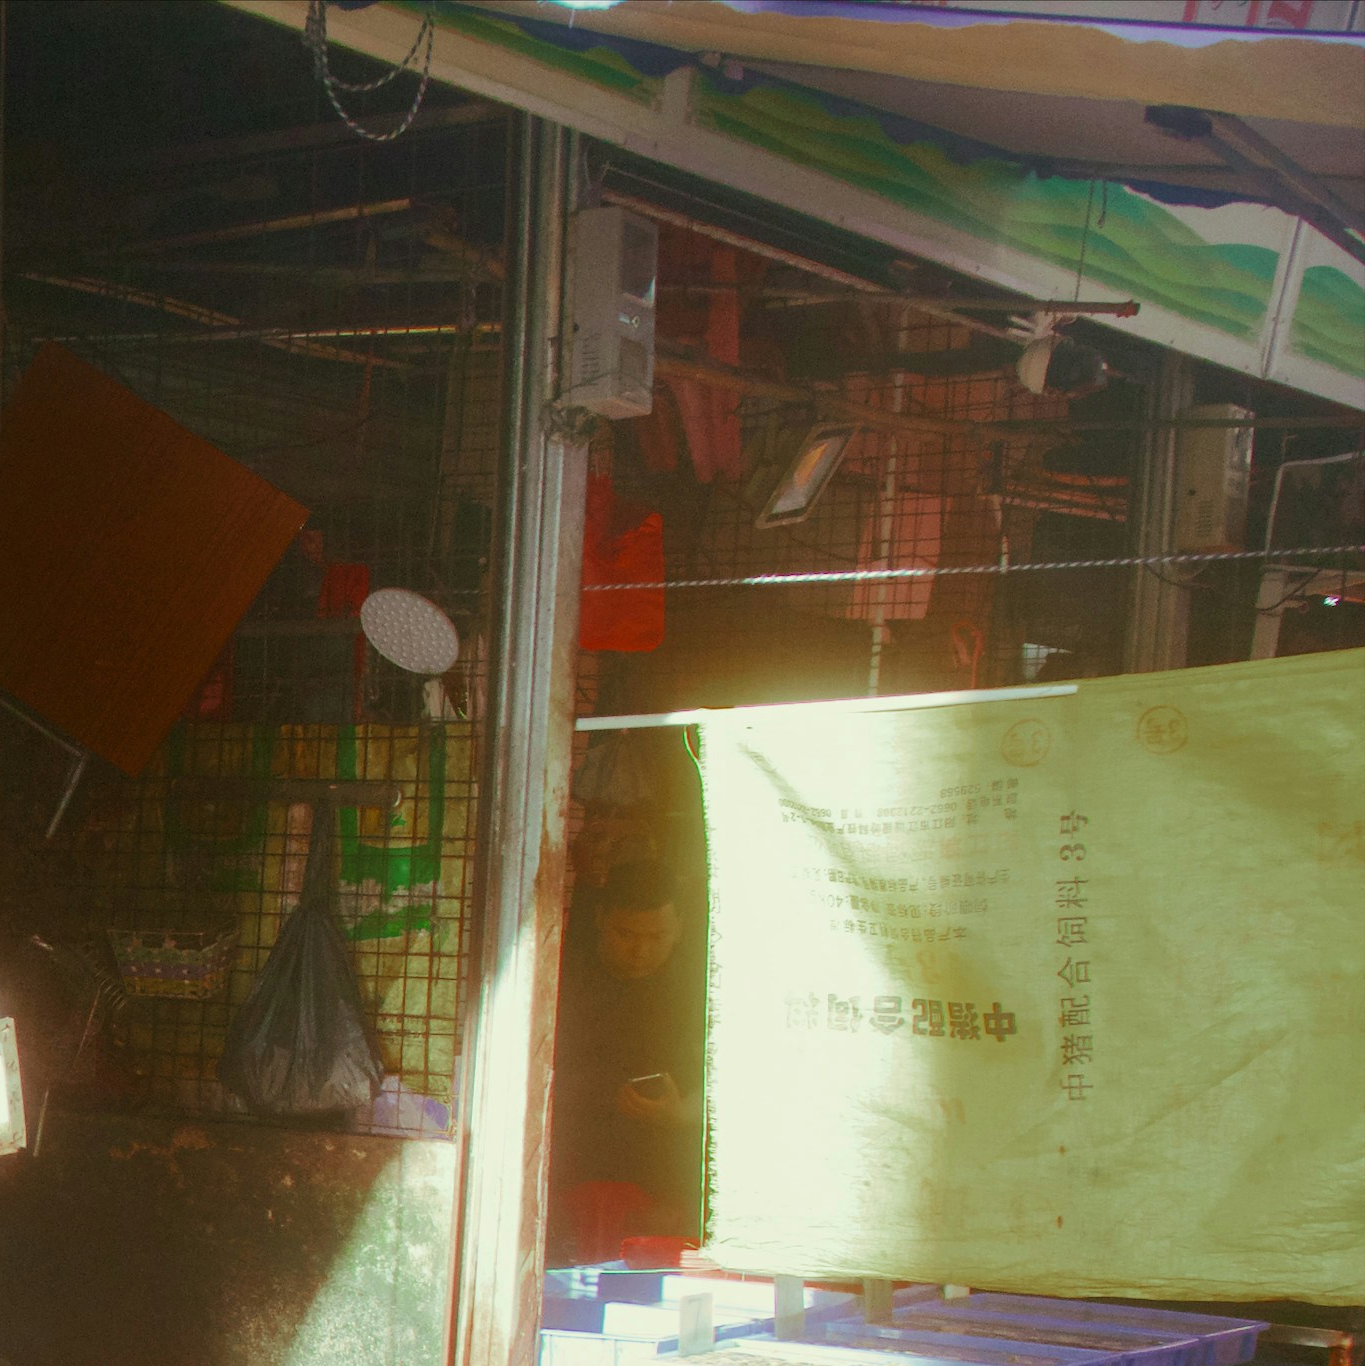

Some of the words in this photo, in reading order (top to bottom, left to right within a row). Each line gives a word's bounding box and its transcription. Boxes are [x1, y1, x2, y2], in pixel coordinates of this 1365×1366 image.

[1057, 808, 1091, 863] 3号
[1055, 875, 1094, 1102] 中猪配合饲料
[782, 991, 1018, 1043] 中猪配合饲料
